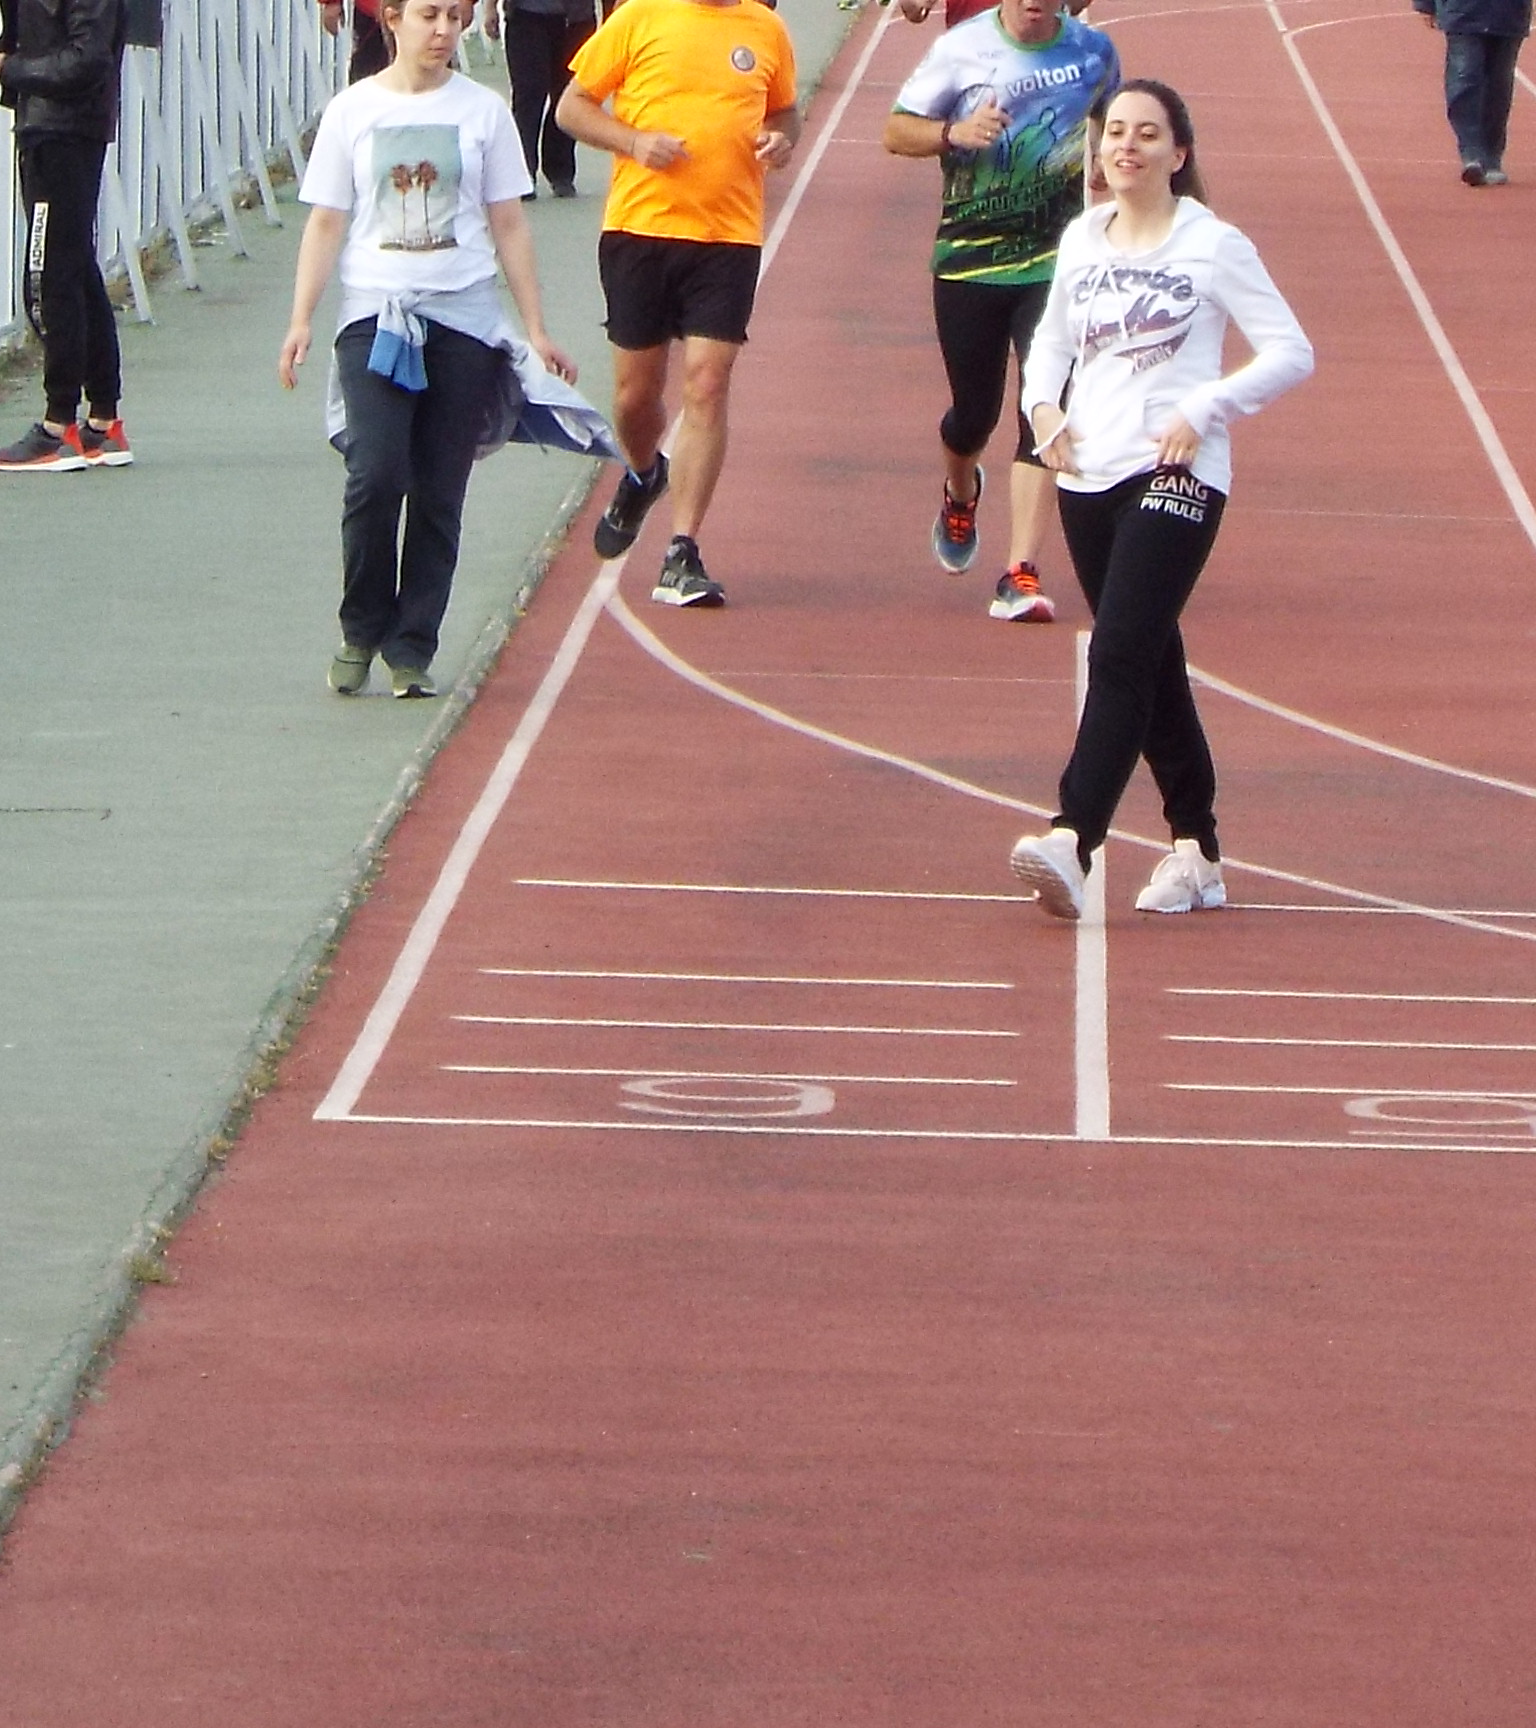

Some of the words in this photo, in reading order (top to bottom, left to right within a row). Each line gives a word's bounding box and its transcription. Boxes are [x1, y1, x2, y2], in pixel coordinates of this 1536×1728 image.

[1005, 64, 1081, 98] volton
[31, 205, 47, 267] ADMIRAL
[1150, 475, 1208, 502] GANG
[1140, 497, 1164, 511] PW
[1163, 499, 1204, 523] RULES
